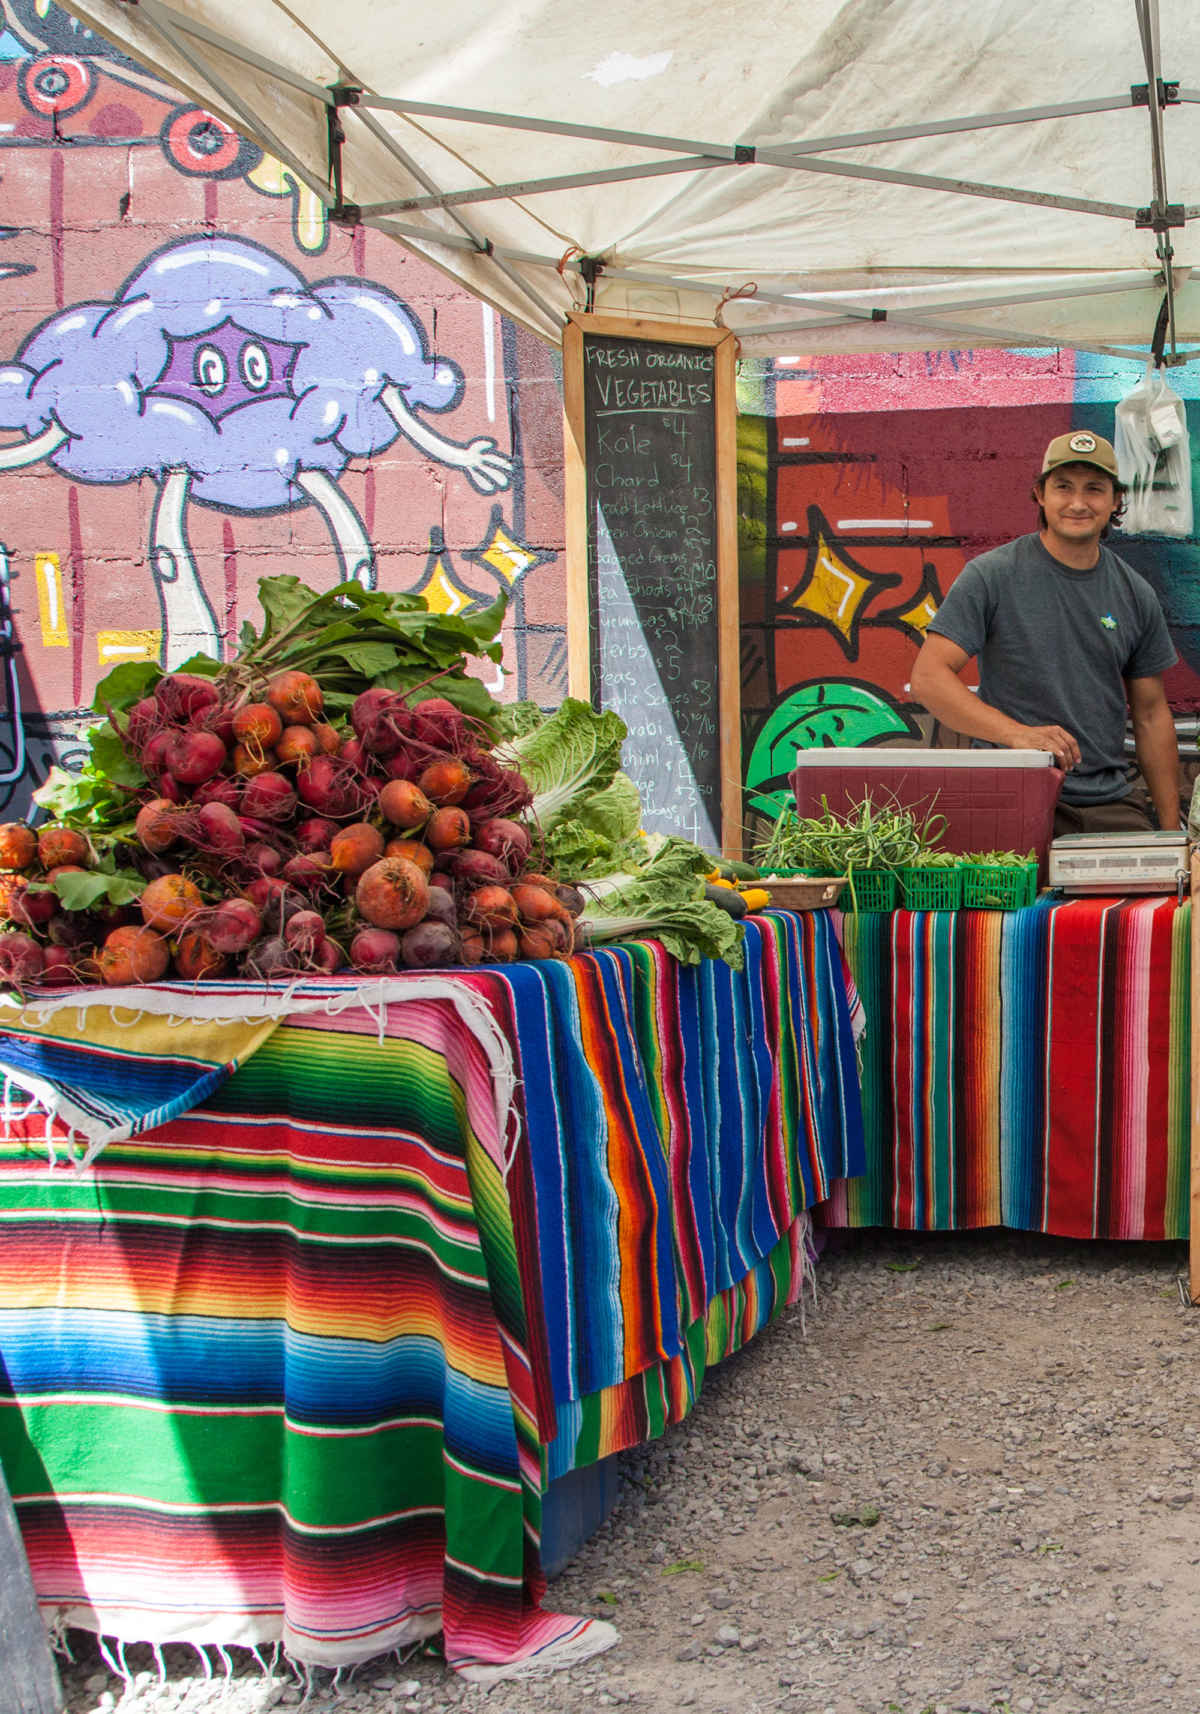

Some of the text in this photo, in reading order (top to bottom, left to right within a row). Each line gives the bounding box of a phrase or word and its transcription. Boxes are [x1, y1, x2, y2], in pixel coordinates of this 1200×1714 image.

[585, 346, 713, 372] FRESH ORGANIC
[595, 375, 711, 407] VEGETABLES
[596, 424, 651, 455] Kale
[595, 463, 660, 488] Chard
[594, 630, 649, 659] Herbs
[592, 664, 638, 686] Peas
[641, 799, 680, 820] abbage
